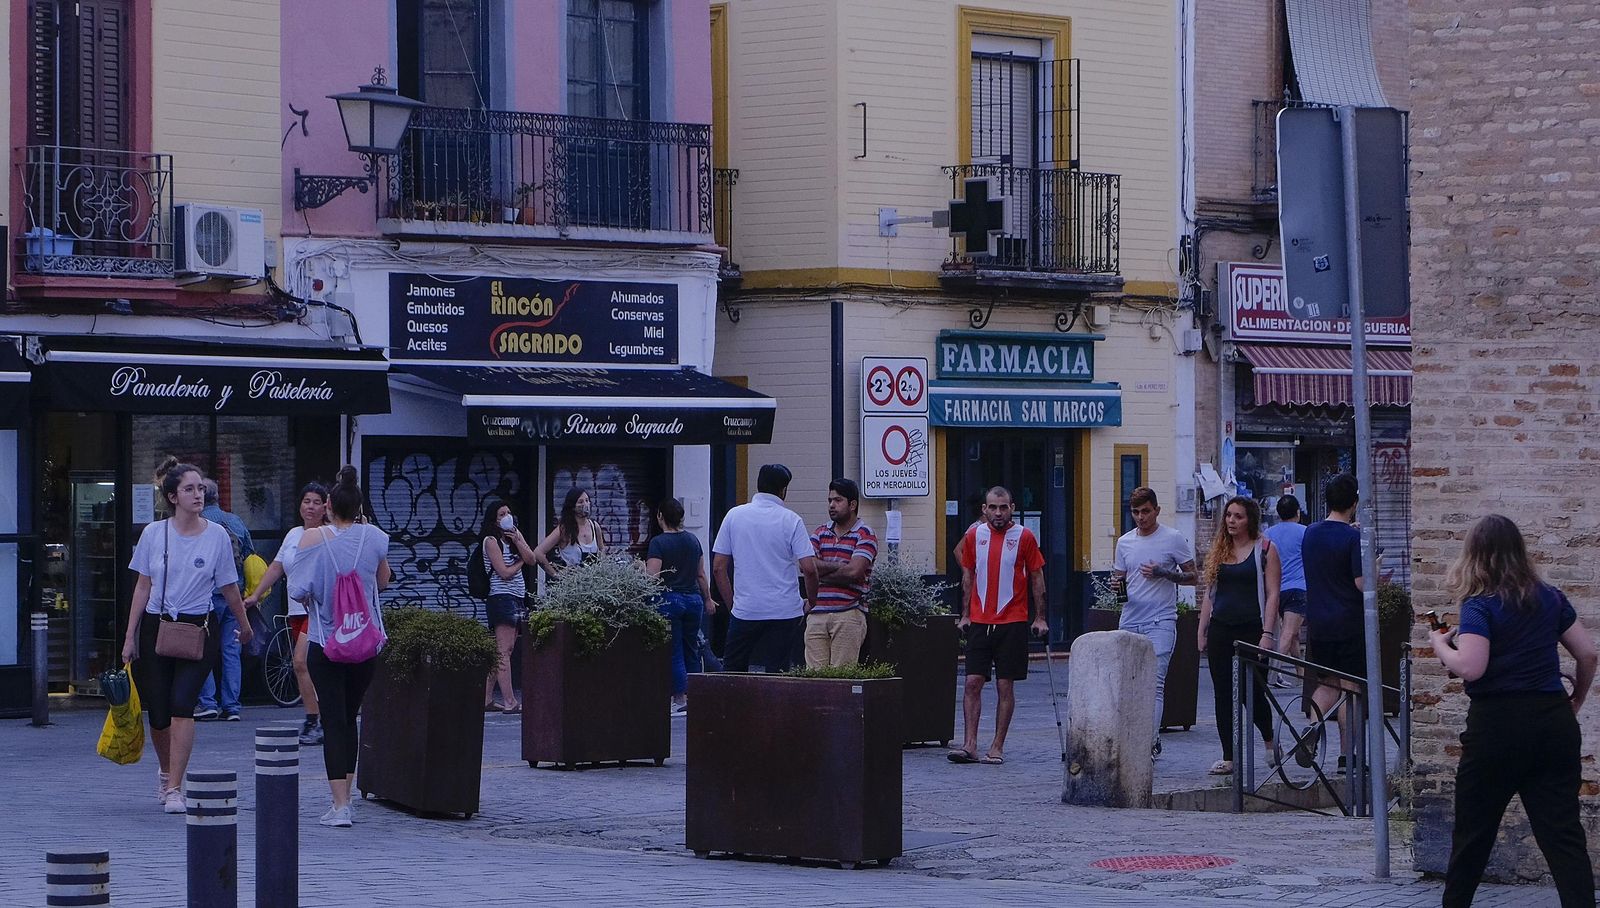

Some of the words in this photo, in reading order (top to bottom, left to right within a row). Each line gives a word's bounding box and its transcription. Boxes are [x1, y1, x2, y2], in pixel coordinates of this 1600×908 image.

[406, 283, 456, 298] Jamones
[491, 281, 503, 296] EL
[491, 292, 553, 316] RINCÓN
[610, 290, 665, 304] Ahumados
[406, 302, 465, 316] Embutidos
[611, 308, 665, 321] Conservas
[407, 320, 449, 333] Quesos
[1240, 317, 1331, 332] ALIMENTACION
[643, 326, 664, 339] Miel
[406, 338, 447, 351] Aceites
[499, 332, 583, 355] SAGRADO
[609, 342, 665, 357] Legumbres
[941, 343, 1090, 374] FARMACIA
[110, 366, 211, 398] Panadería
[215, 385, 233, 410] y
[248, 370, 333, 400] Pastelería
[944, 399, 1012, 422] FARMACIA
[1021, 400, 1047, 423] SAN
[1053, 401, 1105, 423] MARCOS
[482, 414, 520, 427] Cruzcampo
[564, 413, 618, 434] Rincón
[624, 413, 684, 439] Sagrado
[875, 469, 889, 478] LOS
[891, 469, 918, 478] JUEVES
[866, 481, 881, 489] POR
[883, 481, 927, 489] MERCADILLO
[343, 611, 364, 629] NIKE
